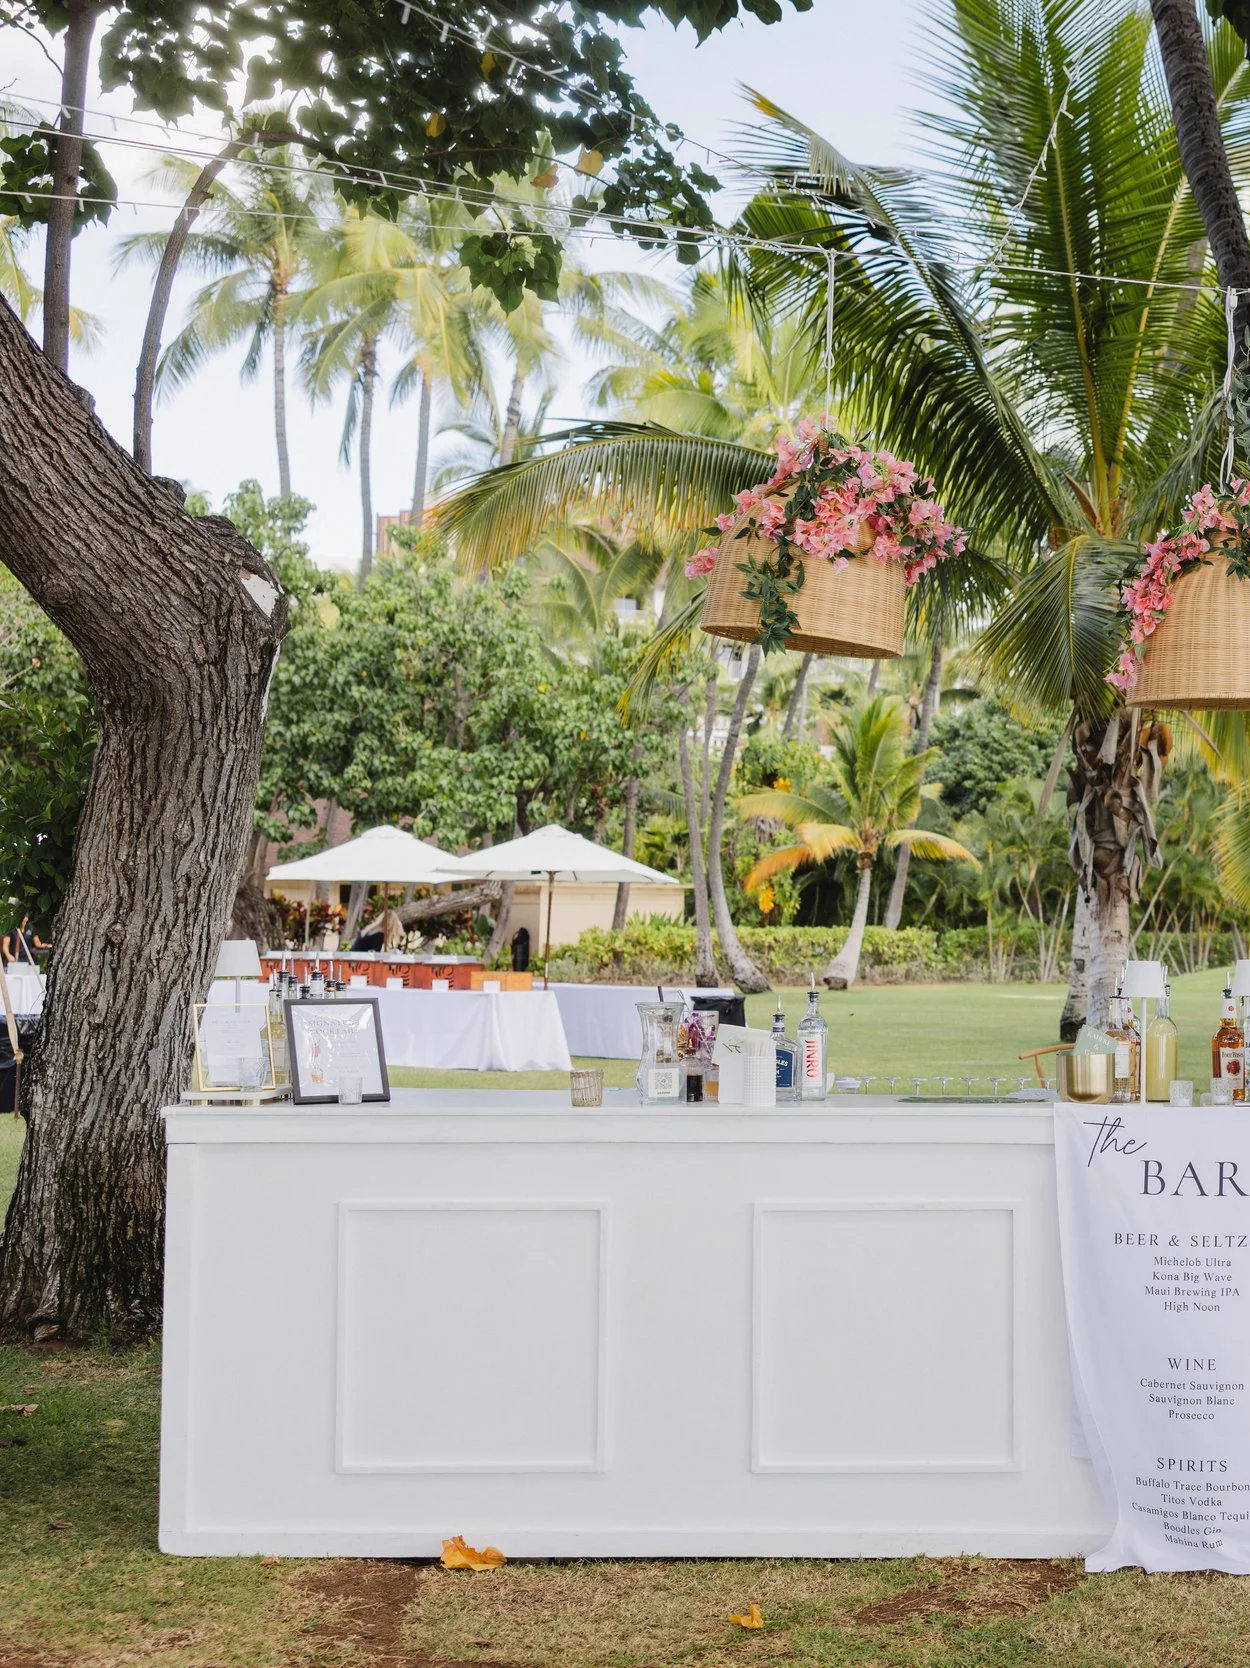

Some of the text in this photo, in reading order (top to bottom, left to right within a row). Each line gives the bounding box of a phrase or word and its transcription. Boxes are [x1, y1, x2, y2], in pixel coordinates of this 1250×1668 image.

[804, 1039, 818, 1078] JINRO
[1083, 1115, 1148, 1168] the
[1139, 1159, 1250, 1197] BAR
[1114, 1233, 1159, 1246] BEER
[1169, 1235, 1180, 1247] &
[1154, 1257, 1231, 1269] Michelob Ultra
[1153, 1271, 1232, 1284] Kona Big Wave
[1145, 1286, 1240, 1299] Maui Brewing IPA
[1164, 1301, 1220, 1313] High Noon
[1168, 1357, 1216, 1371] WINE
[1139, 1377, 1244, 1392] Cabernet Sauvignon
[1148, 1393, 1235, 1407] Sauvignon Blanc
[1168, 1409, 1214, 1420] Prosecco
[1157, 1457, 1227, 1472] SPIRITS
[1135, 1477, 1250, 1492] Buffalo Trace Bourbon
[1161, 1494, 1223, 1507] Titos Vodka
[1131, 1502, 1179, 1519] Casamigos
[1182, 1511, 1216, 1521] Blanco
[1163, 1522, 1201, 1536] Boodles
[1164, 1534, 1199, 1549] Mahina
